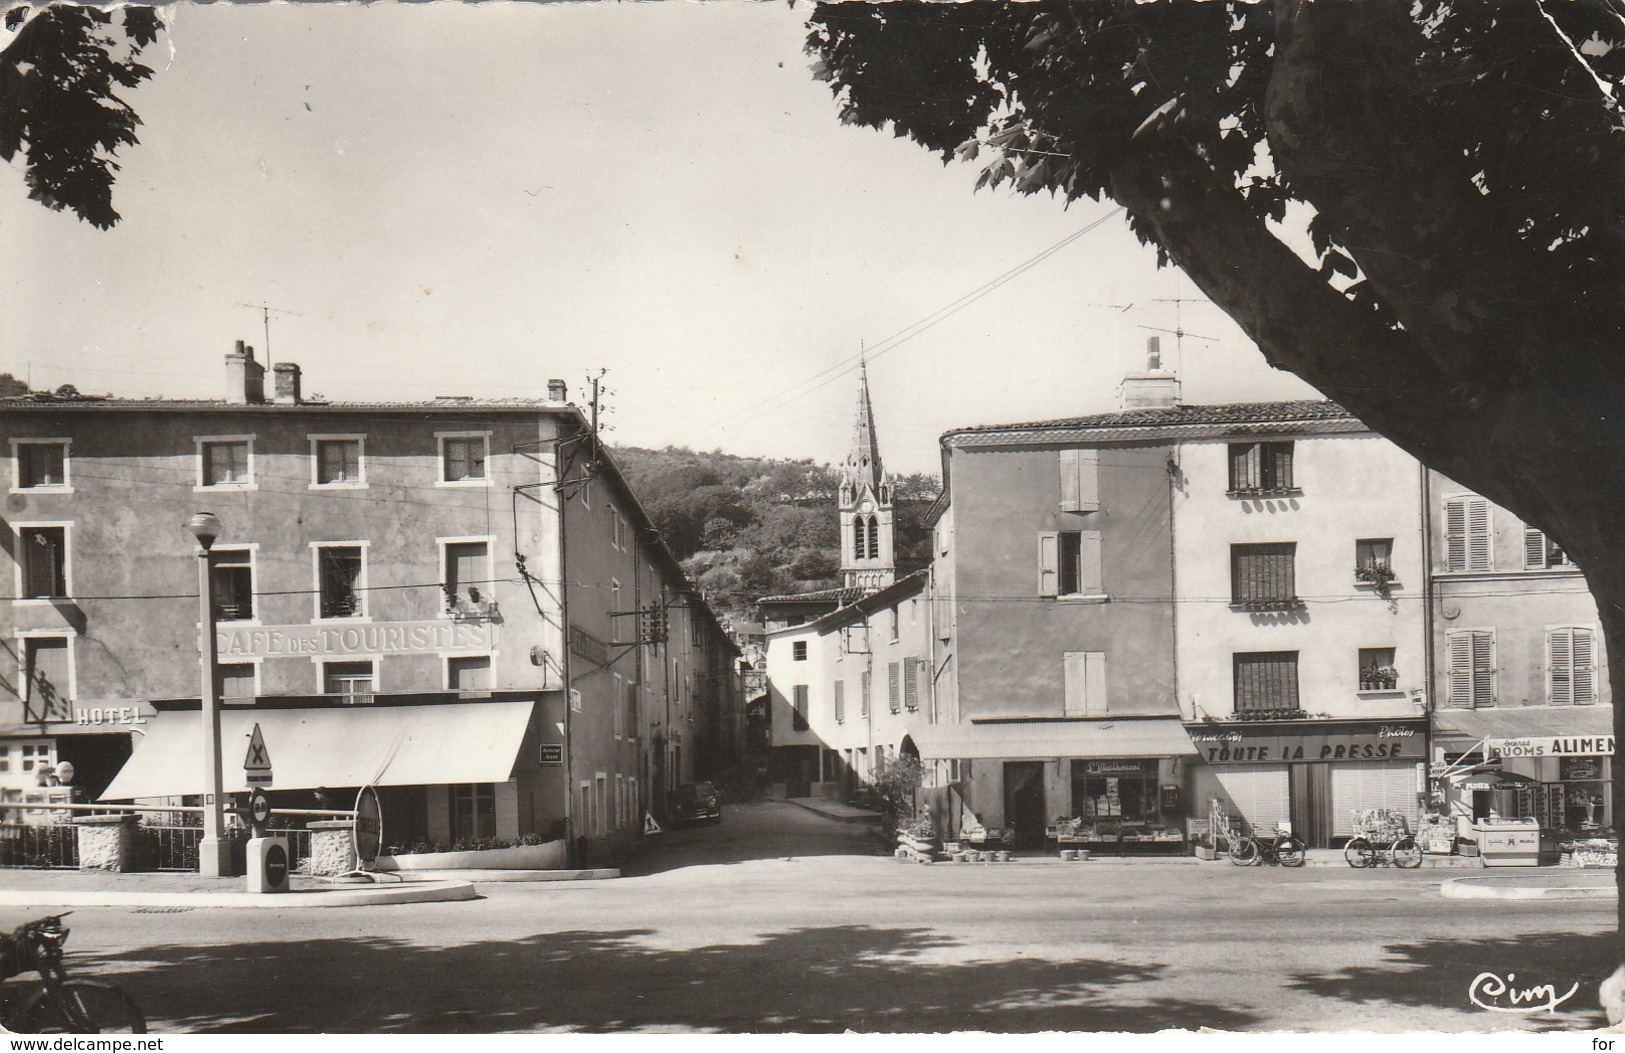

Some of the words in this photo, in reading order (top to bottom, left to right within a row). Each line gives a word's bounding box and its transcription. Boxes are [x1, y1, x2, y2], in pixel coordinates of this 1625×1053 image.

[288, 637, 318, 654] DES
[317, 625, 487, 653] TOURISTES
[77, 707, 147, 725] HOTEL
[1378, 725, 1415, 738] Photos
[1208, 746, 1270, 761] TOUTE
[1282, 745, 1304, 759] LA
[1319, 743, 1402, 759] PRESSE
[1493, 746, 1544, 757] RUOMS
